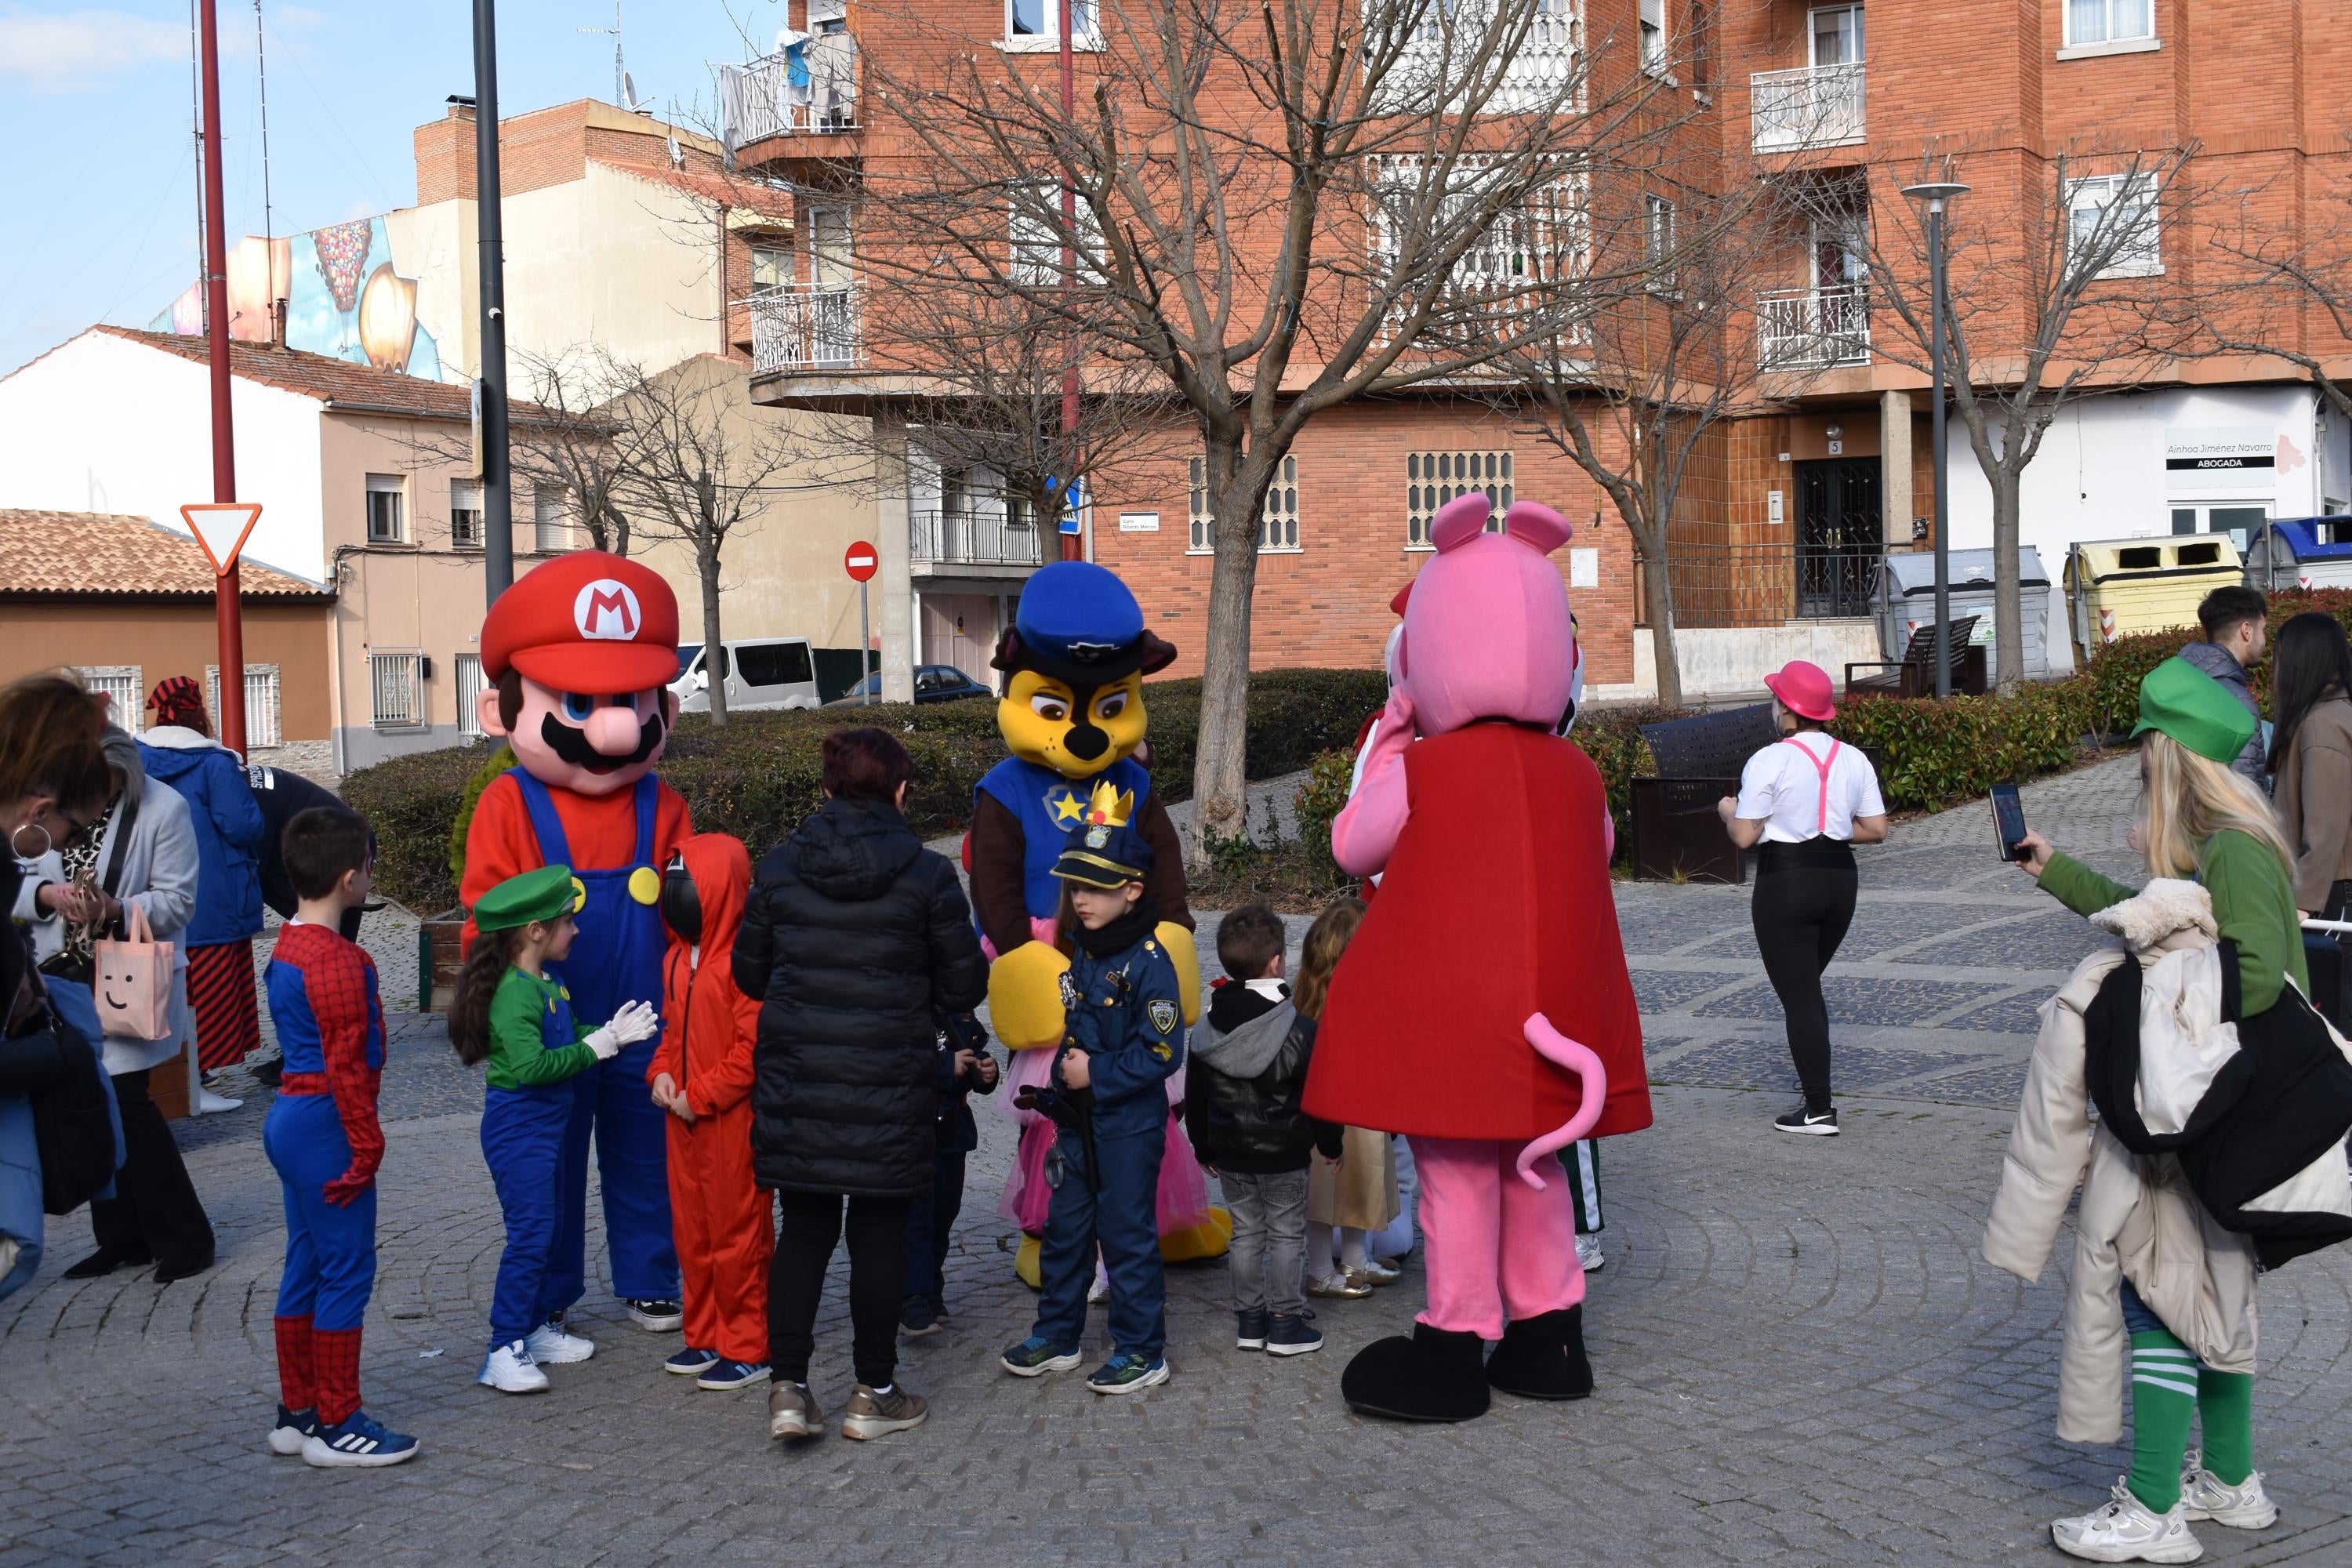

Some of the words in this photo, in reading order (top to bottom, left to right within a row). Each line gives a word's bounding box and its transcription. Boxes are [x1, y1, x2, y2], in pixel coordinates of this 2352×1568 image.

[1832, 443, 1838, 452] 5
[2167, 445, 2198, 453] Ainhoa
[2200, 444, 2236, 453] Jiménez
[2238, 444, 2272, 452] Navarro
[2197, 459, 2242, 468] ABOGADA
[584, 587, 635, 634] M
